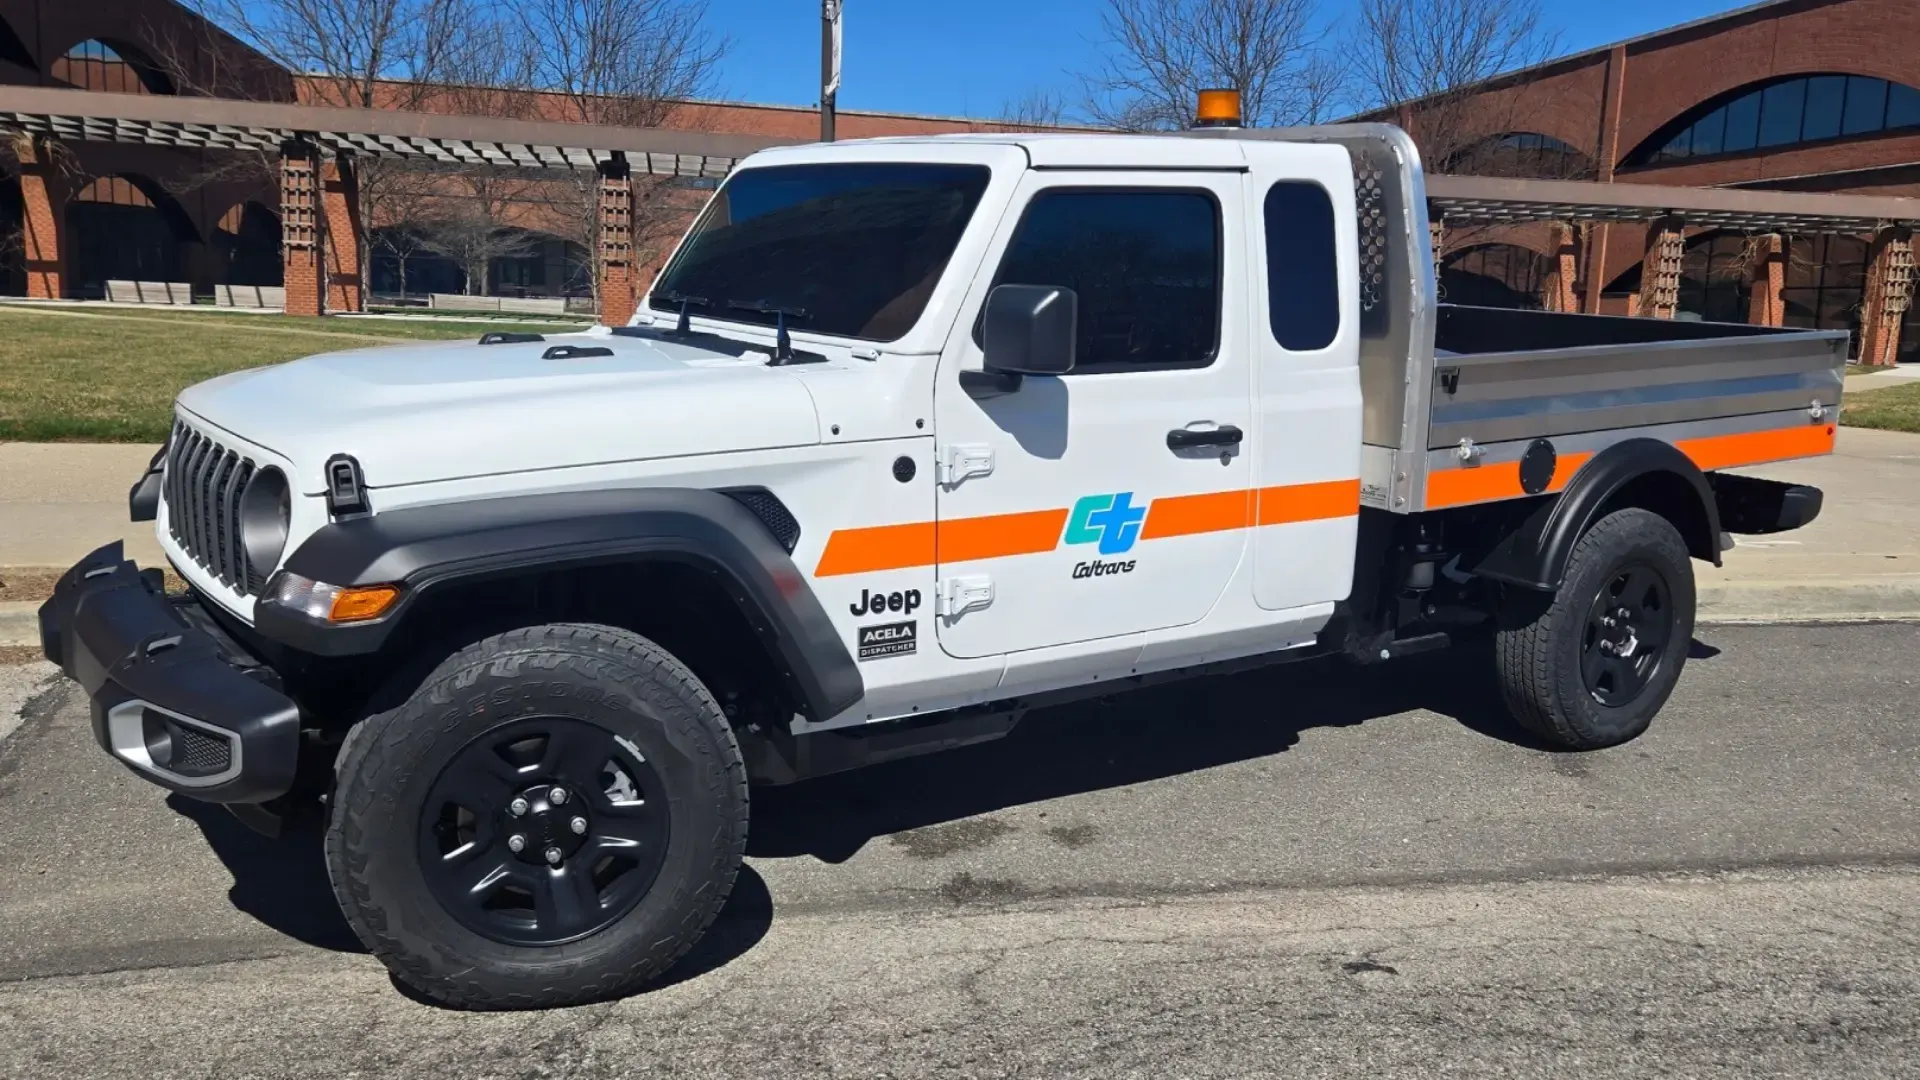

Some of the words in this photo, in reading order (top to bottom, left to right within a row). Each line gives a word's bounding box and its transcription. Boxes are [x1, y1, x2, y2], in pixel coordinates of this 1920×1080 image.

[1072, 560, 1136, 579] Caltrans
[849, 588, 921, 616] Jeep
[863, 626, 912, 643] ACELA
[860, 642, 914, 656] DISPATCHER
